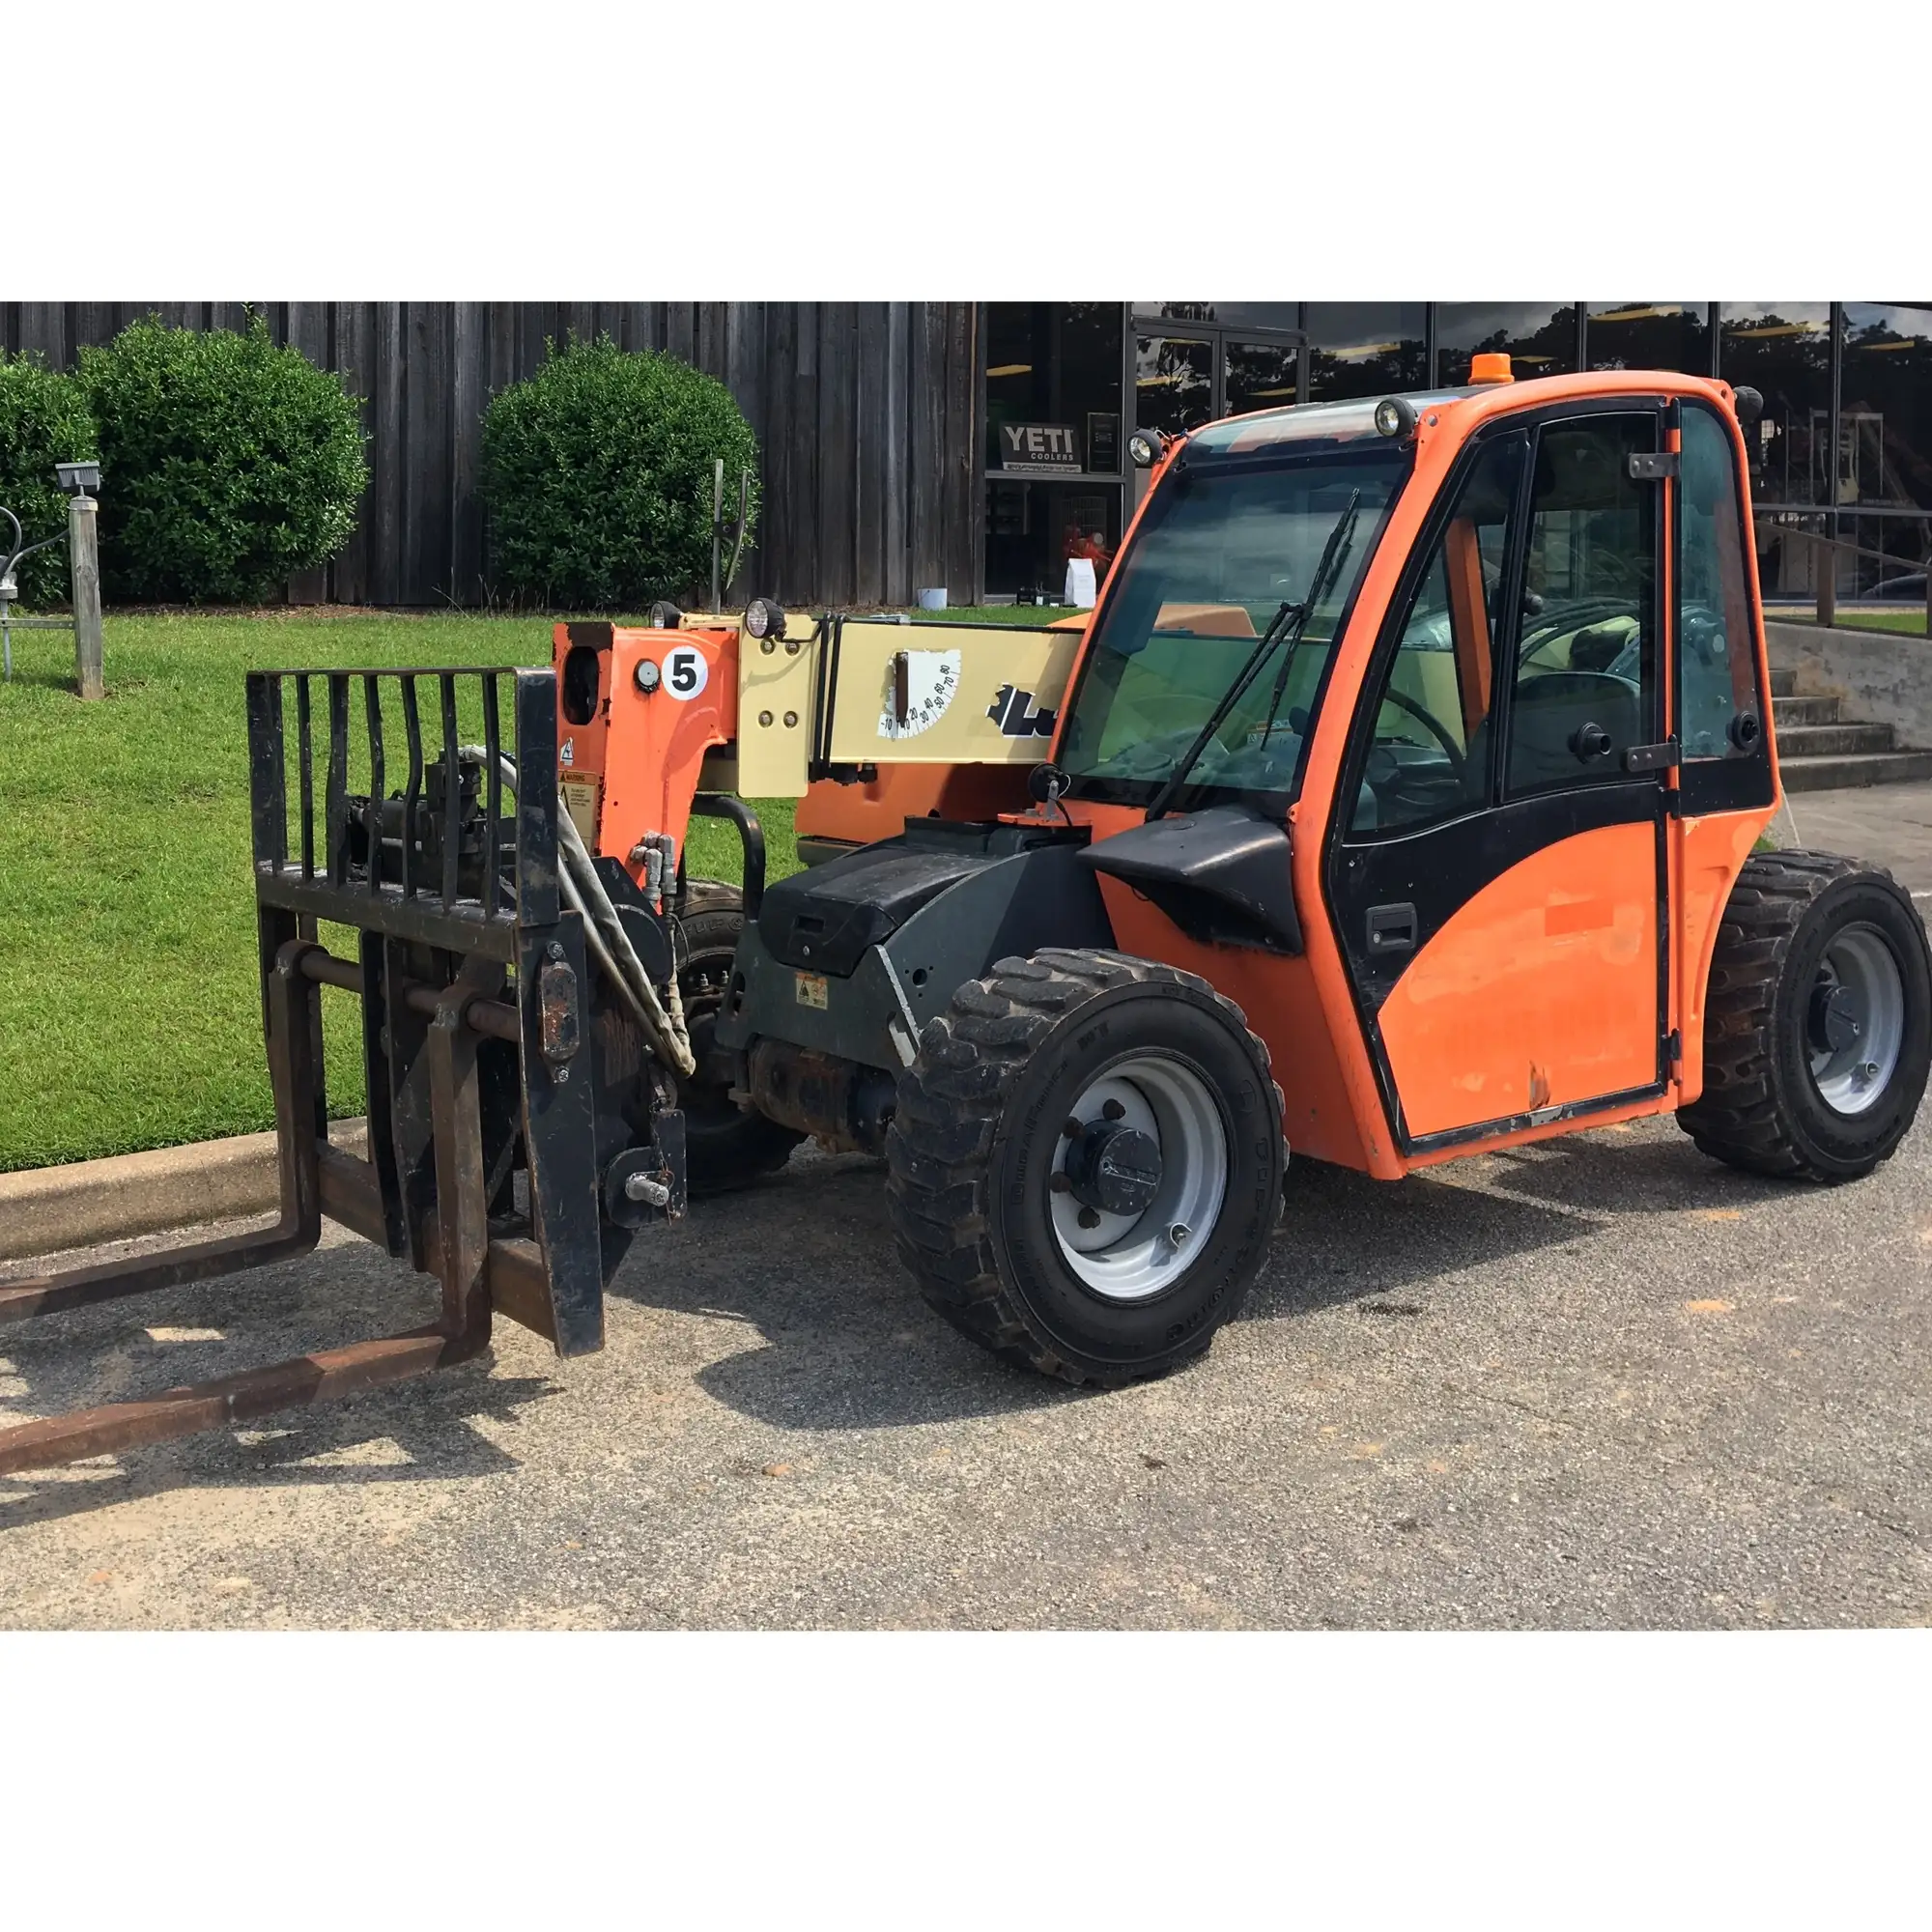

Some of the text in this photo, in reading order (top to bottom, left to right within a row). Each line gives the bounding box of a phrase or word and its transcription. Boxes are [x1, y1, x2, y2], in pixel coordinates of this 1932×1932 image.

[1005, 426, 1073, 453] YETI
[671, 654, 697, 692] 5
[933, 682, 945, 695] 60
[943, 676, 954, 688] 70
[923, 697, 934, 710] 40
[933, 696, 945, 709] 50
[909, 707, 919, 721] 20
[919, 710, 929, 724] 30
